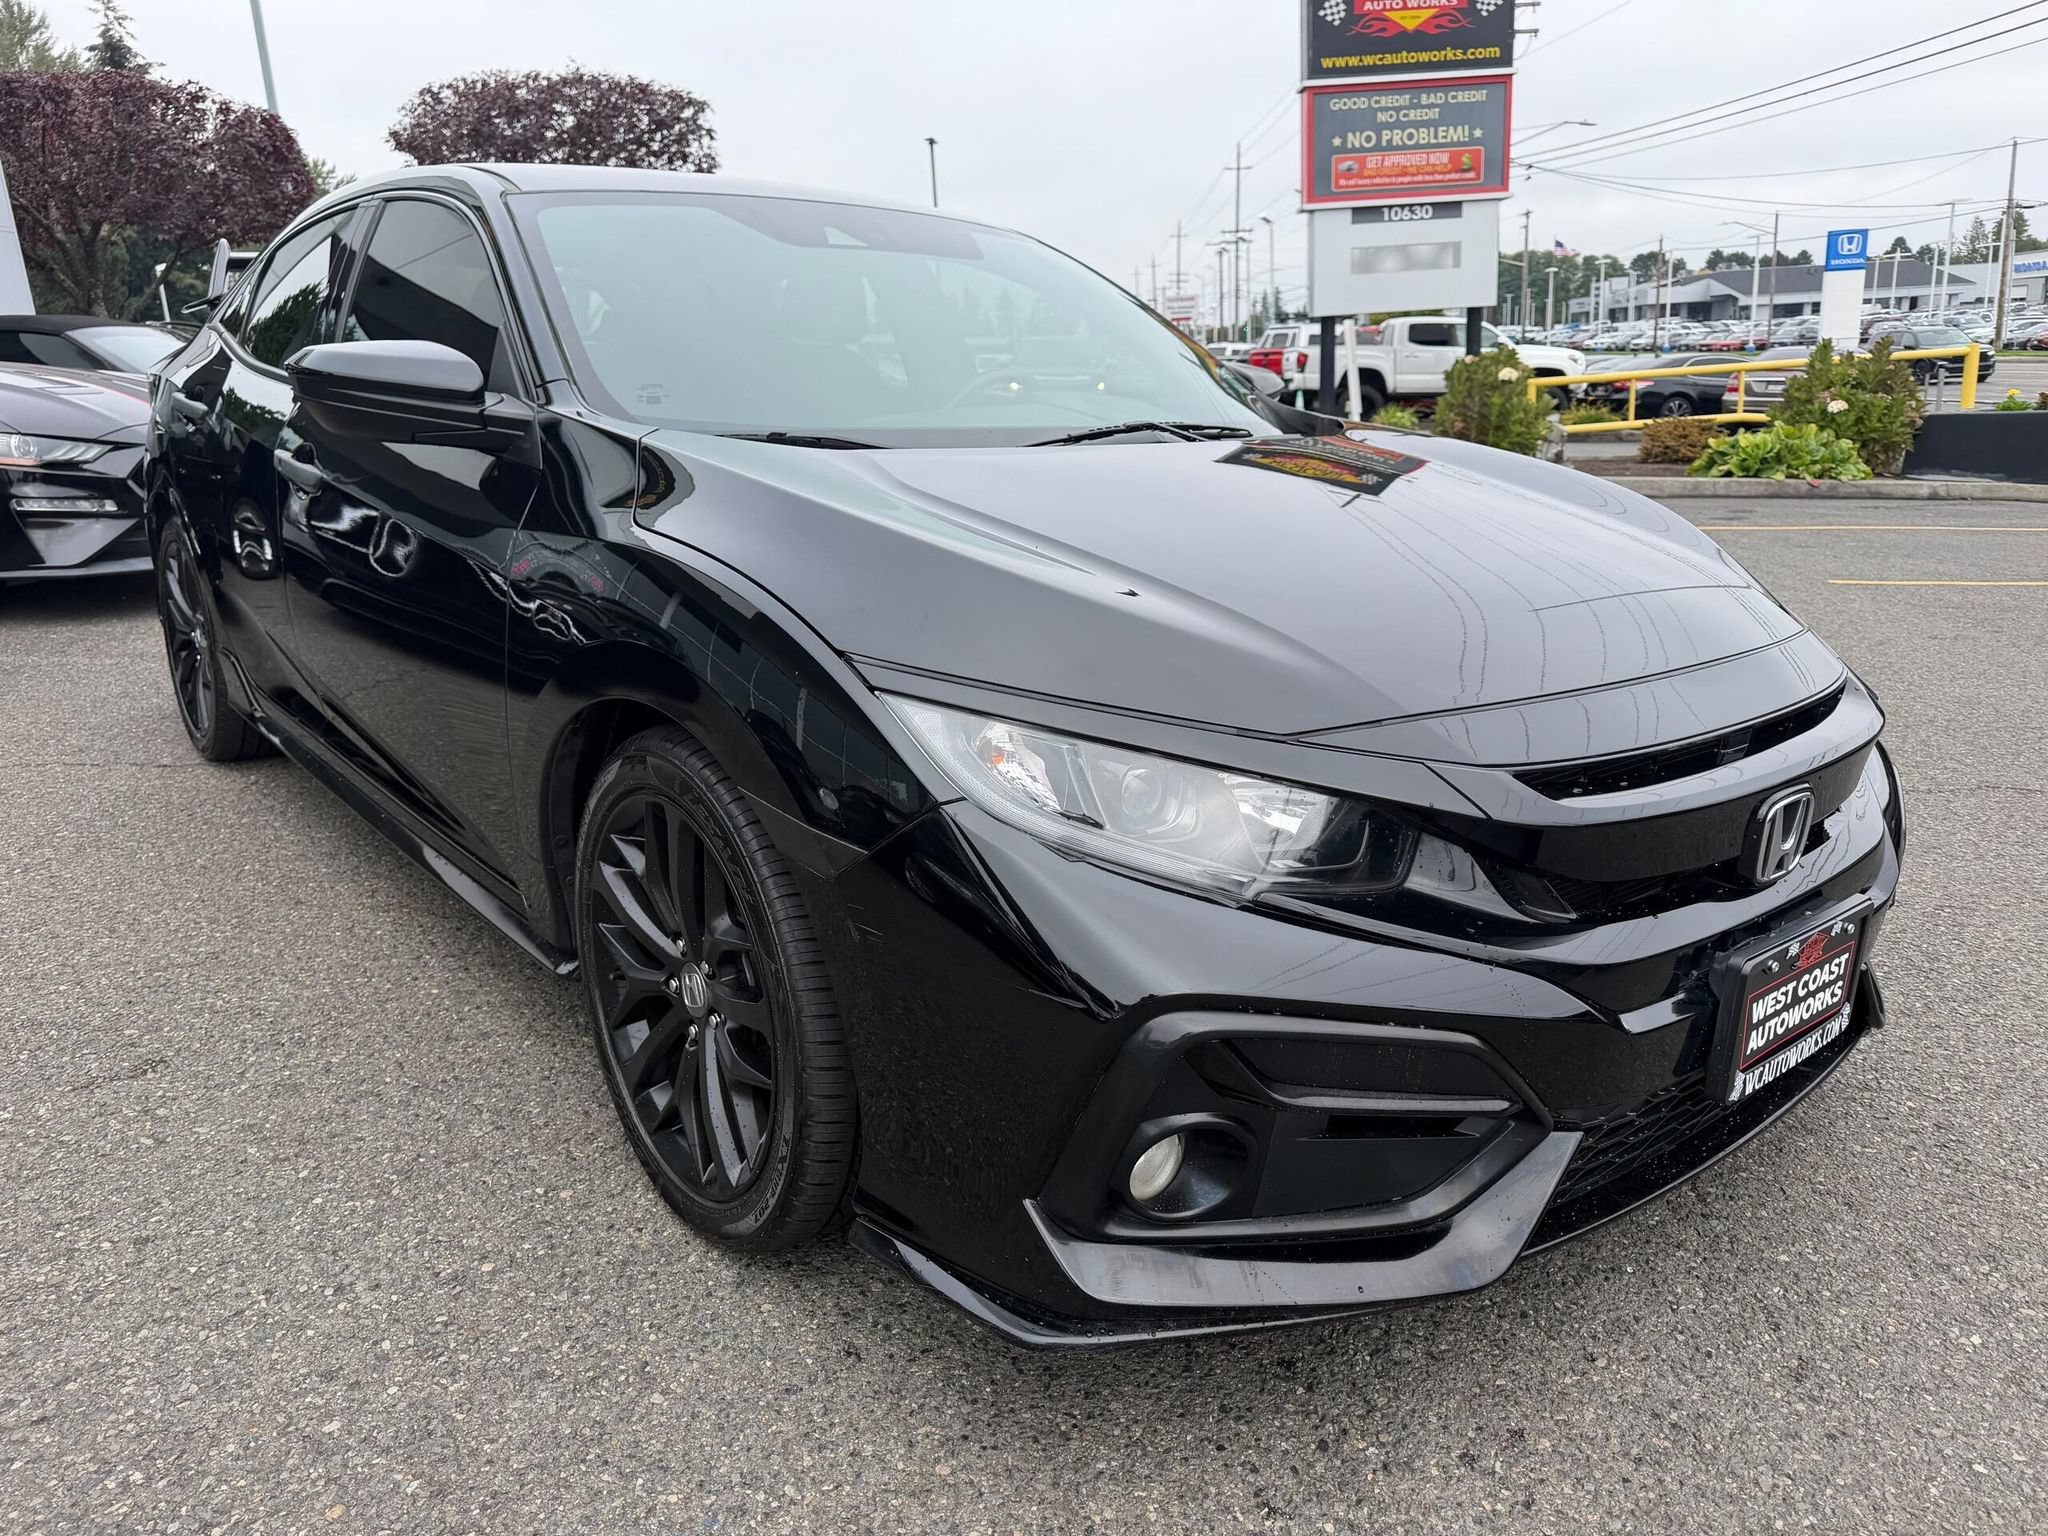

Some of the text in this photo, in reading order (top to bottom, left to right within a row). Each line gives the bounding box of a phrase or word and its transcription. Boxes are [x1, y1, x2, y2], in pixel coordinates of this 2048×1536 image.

[1363, 0, 1403, 11] AUTO
[1320, 46, 1500, 69] www.wcautoworks.com
[1329, 97, 1368, 111] GOOD
[1371, 95, 1410, 109] CREDIT
[1420, 92, 1447, 105] BAD
[1448, 90, 1488, 103] CREDIT
[1376, 108, 1440, 123] NO CREDIT
[1346, 125, 1469, 149] NO PROBLEM!
[1381, 205, 1432, 221] 10630
[1752, 952, 1849, 1024] WEST COAST
[1746, 980, 1843, 1055] AUTOWORKS
[1744, 1015, 1843, 1096] WCAUTOWORKS.COM
